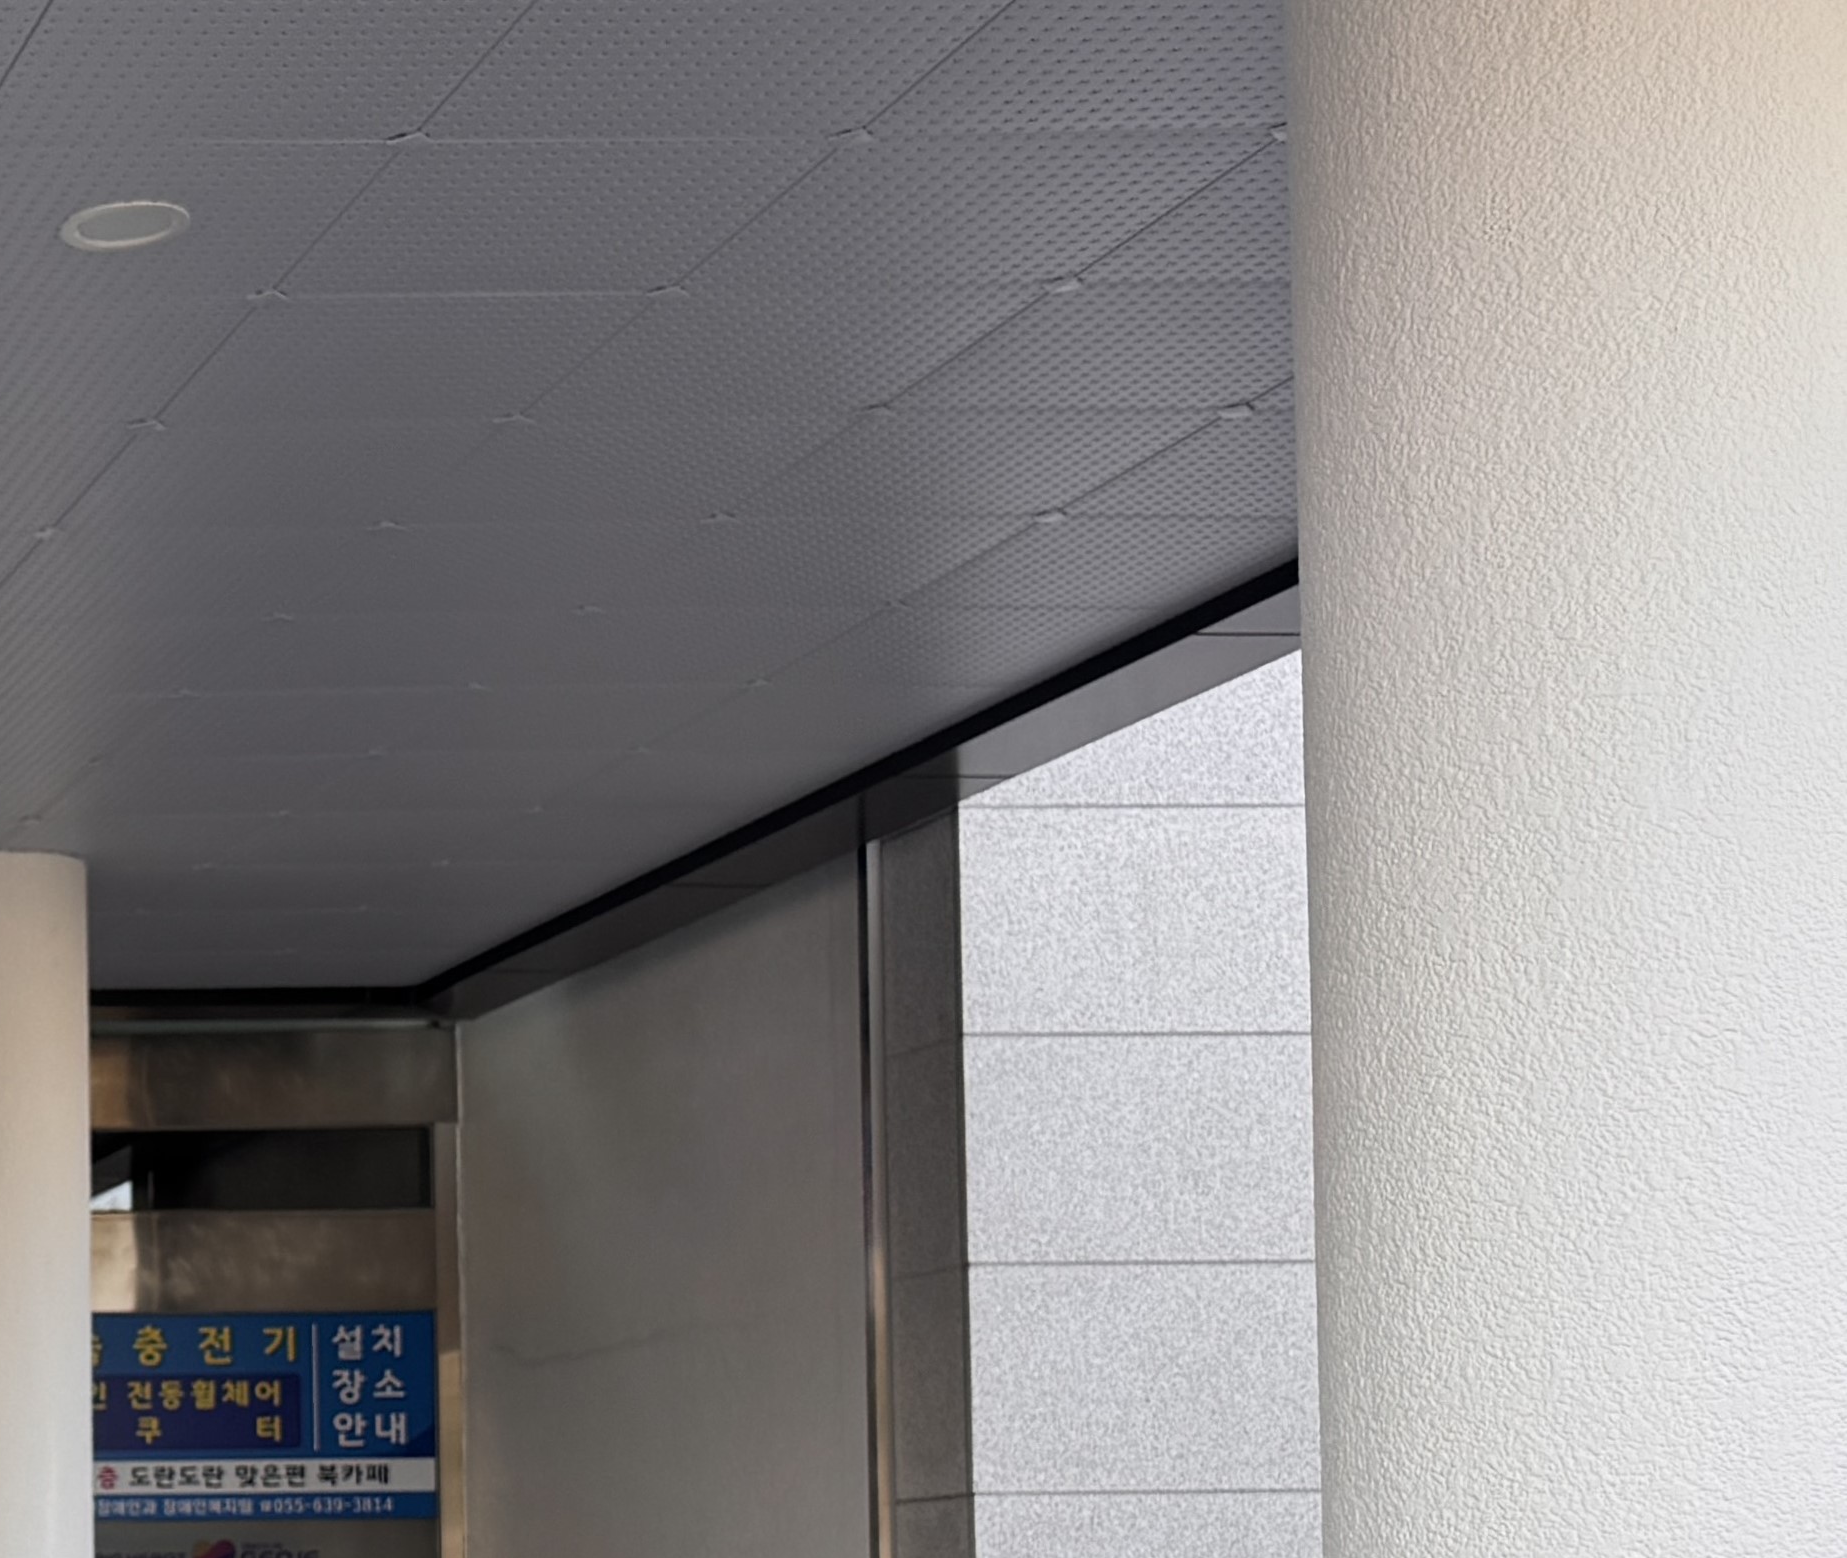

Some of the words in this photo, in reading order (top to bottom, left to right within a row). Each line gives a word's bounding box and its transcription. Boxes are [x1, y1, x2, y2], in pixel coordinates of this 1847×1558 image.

[333, 1325, 403, 1360] 설치
[333, 1370, 405, 1404] 장소
[333, 1412, 406, 1447] 안내
[130, 1465, 224, 1488] 도란도란
[235, 1464, 305, 1488] 맞은편
[318, 1464, 389, 1486] 북카페
